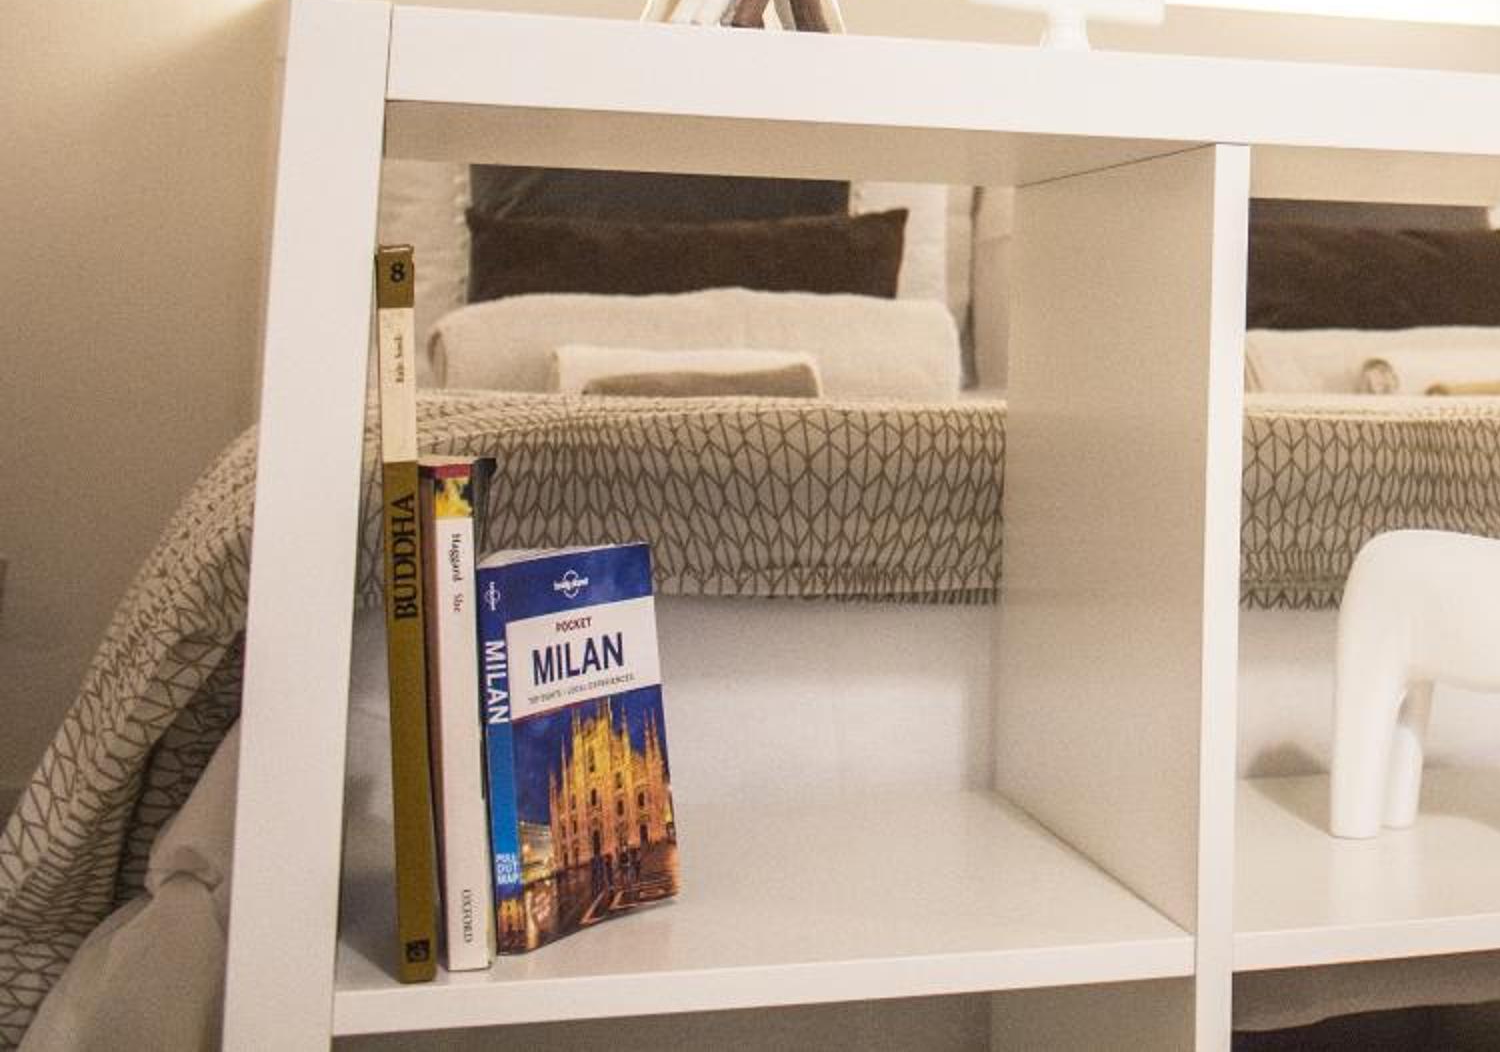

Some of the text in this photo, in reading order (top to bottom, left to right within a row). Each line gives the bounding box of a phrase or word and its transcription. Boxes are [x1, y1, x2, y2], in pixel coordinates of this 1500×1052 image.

[391, 261, 405, 283] 8
[393, 493, 417, 623] BUDDHA
[450, 533, 464, 613] Haggard She
[555, 616, 592, 632] POCKET
[485, 640, 510, 724] MILAN
[532, 632, 624, 686] MILAN
[463, 889, 474, 943] OXFORD
